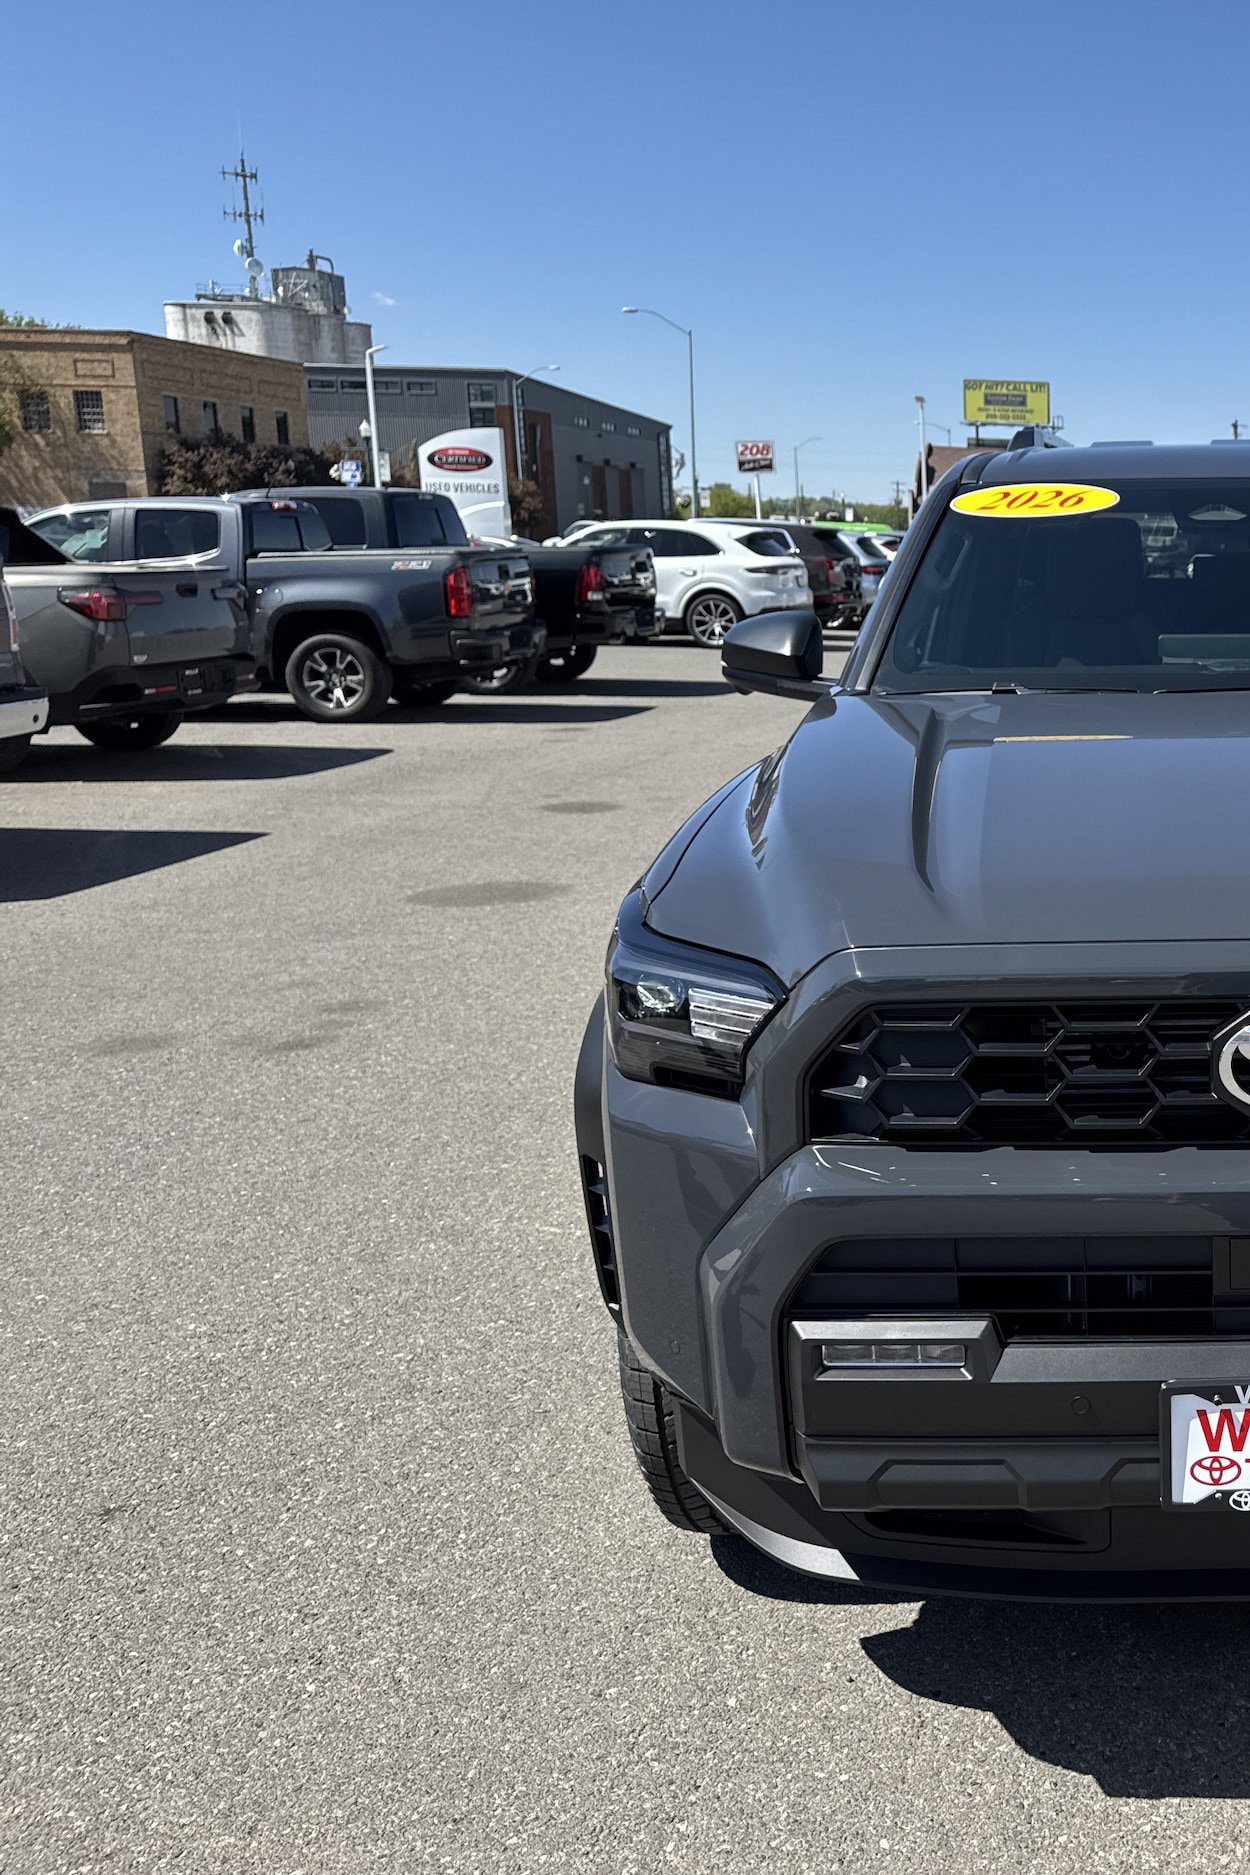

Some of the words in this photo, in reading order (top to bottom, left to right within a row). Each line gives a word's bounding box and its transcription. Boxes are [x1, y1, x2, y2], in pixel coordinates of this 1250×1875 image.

[1006, 383, 1029, 392] CALL
[740, 443, 770, 456] 208
[425, 481, 451, 493] USED
[453, 483, 500, 495] VEHICLES
[976, 490, 1095, 511] 2026
